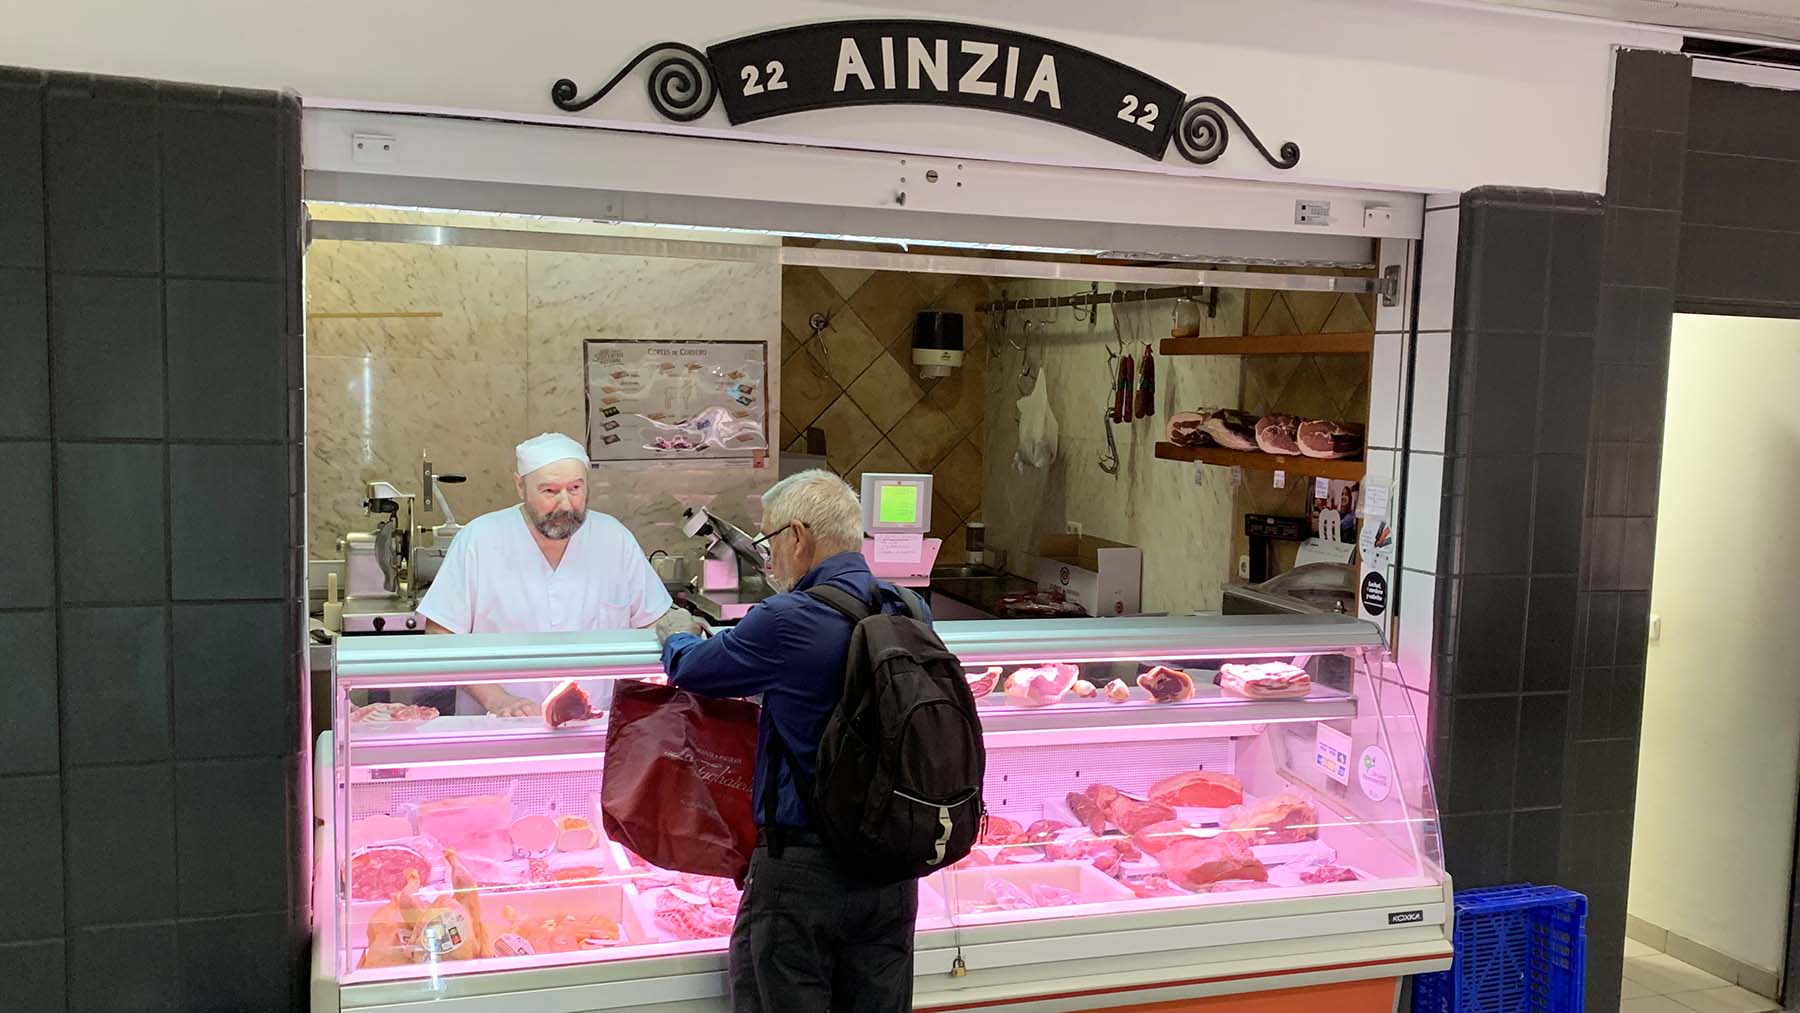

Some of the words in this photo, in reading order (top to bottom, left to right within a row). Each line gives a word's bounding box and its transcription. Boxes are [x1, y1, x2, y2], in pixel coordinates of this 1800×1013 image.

[741, 60, 788, 97] 22
[833, 37, 1061, 110] AINZIA
[1117, 94, 1159, 132] 22
[1392, 913, 1421, 923] KOXKA
